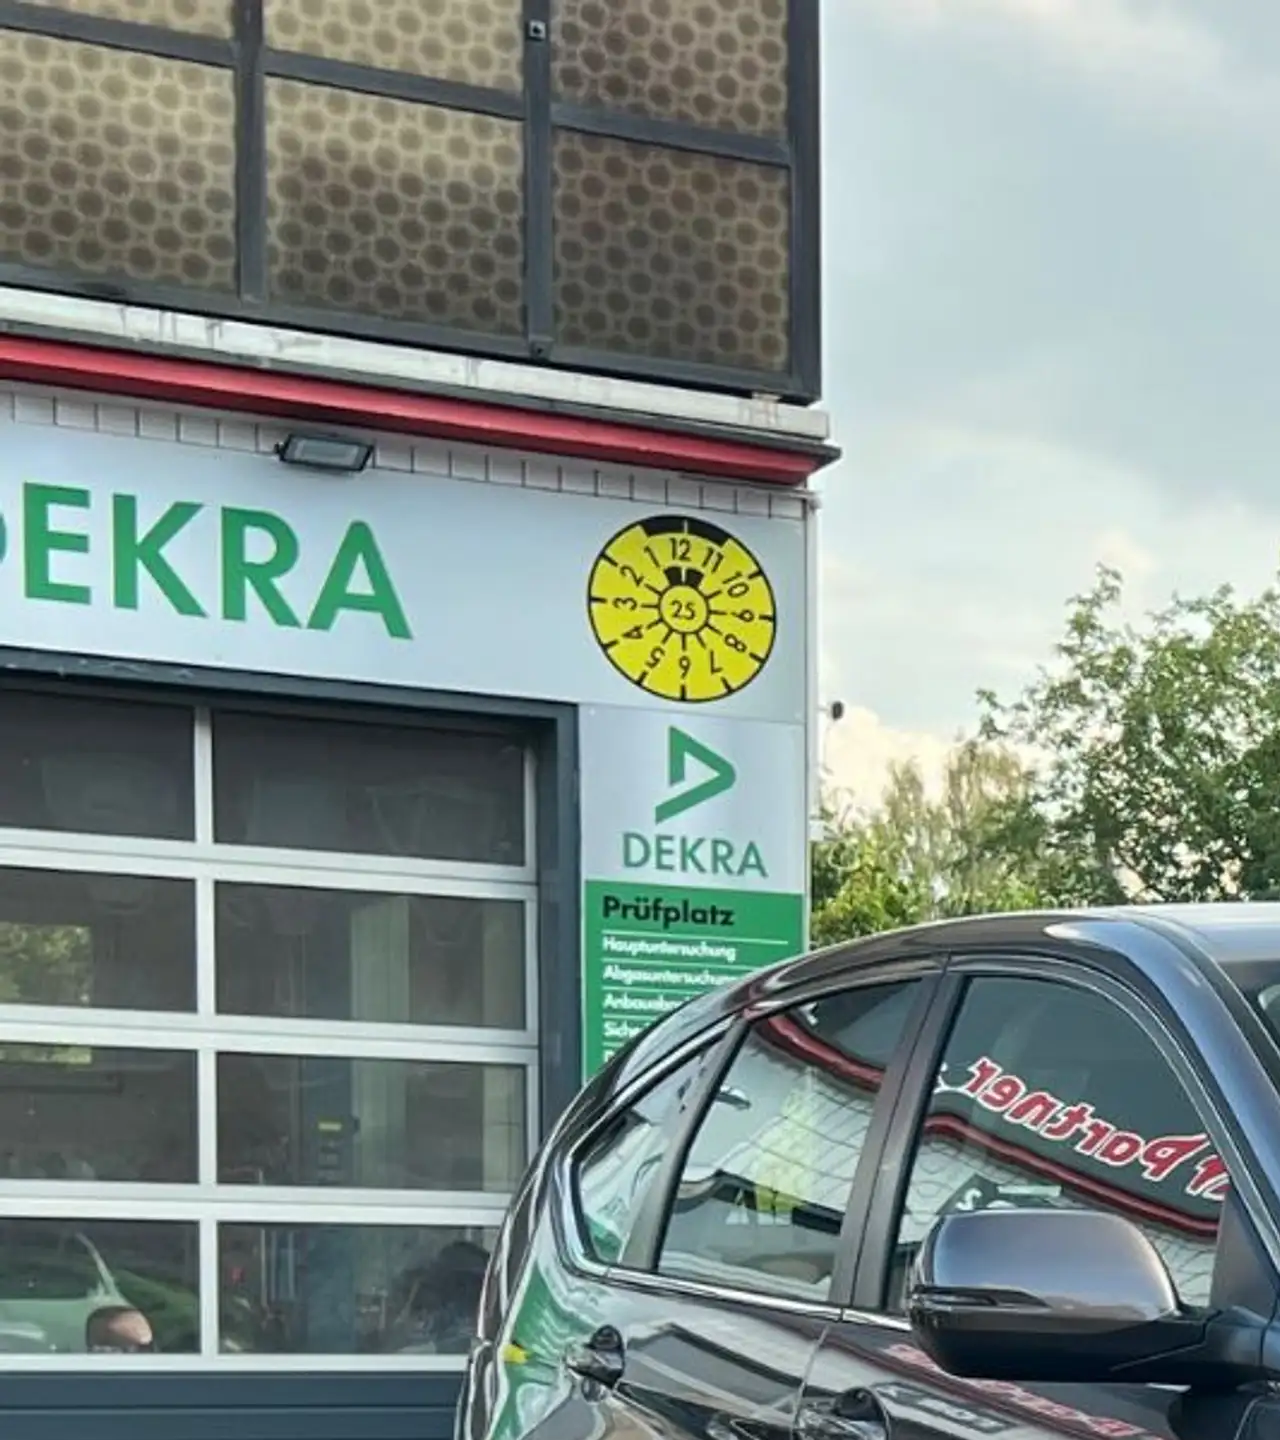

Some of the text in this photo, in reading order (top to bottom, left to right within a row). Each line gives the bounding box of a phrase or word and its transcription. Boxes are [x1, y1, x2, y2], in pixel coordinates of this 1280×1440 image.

[0, 482, 413, 640] EKRA
[669, 537, 692, 562] 12
[701, 547, 725, 573] 11
[619, 564, 646, 588] 2
[721, 570, 750, 599] 10
[611, 596, 638, 611] 3
[670, 599, 696, 621] 25
[621, 624, 645, 640] 4
[723, 633, 748, 653] 8
[645, 646, 666, 670] 5
[708, 650, 724, 675] 7
[622, 832, 769, 879] DEKRA
[602, 895, 735, 929] Prüfplatz
[603, 936, 736, 963] Hauptuntersuchung
